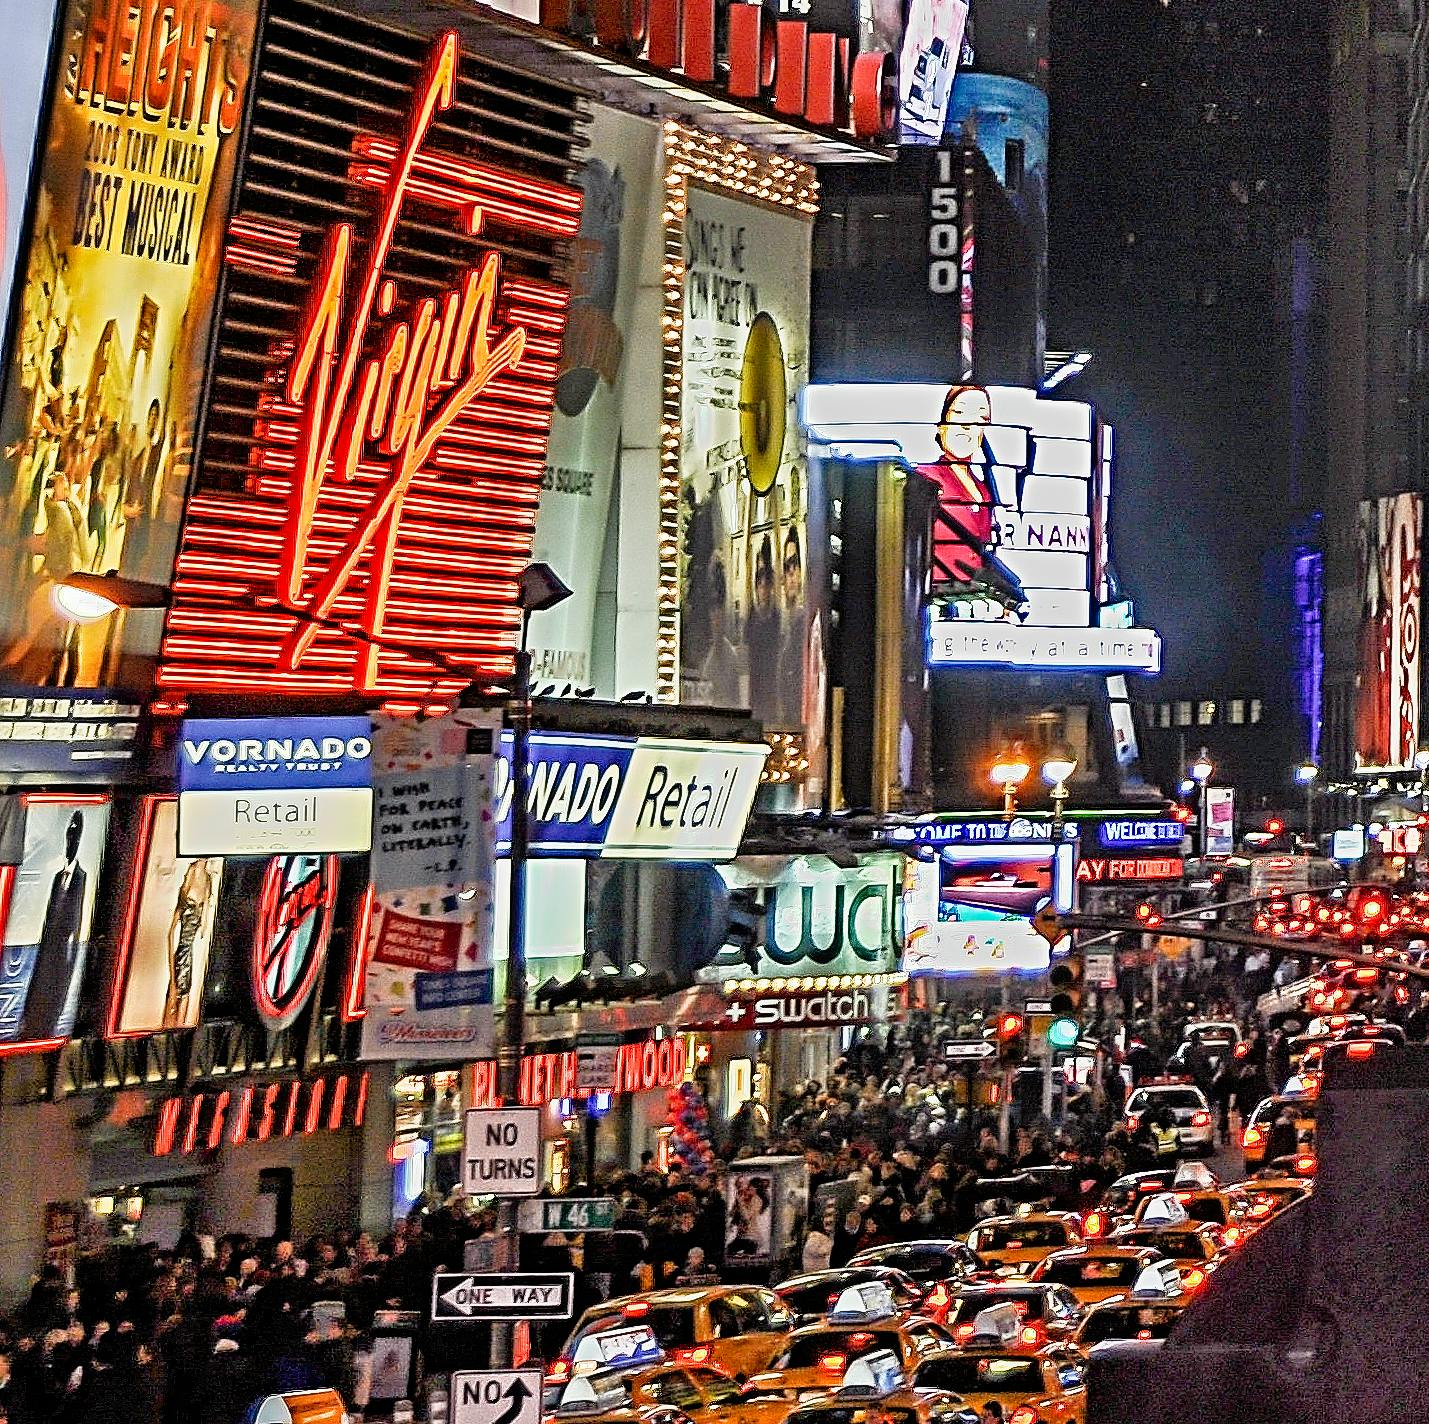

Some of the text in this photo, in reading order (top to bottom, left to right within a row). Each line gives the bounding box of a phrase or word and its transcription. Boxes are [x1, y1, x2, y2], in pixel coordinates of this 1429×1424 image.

[121, 180, 199, 266] MUSICAL
[930, 150, 957, 296] 1500
[290, 30, 526, 690] Virgin
[183, 736, 371, 766] VORNADO
[234, 796, 318, 824] Retail
[379, 803, 410, 817] FOR
[636, 765, 739, 829] Retail
[754, 989, 870, 1025] swatch
[487, 1122, 519, 1146] NO
[468, 1158, 535, 1181] TURNS
[566, 1205, 590, 1229] 46
[455, 1287, 552, 1305] ONE WAY
[463, 1381, 502, 1405] NO
